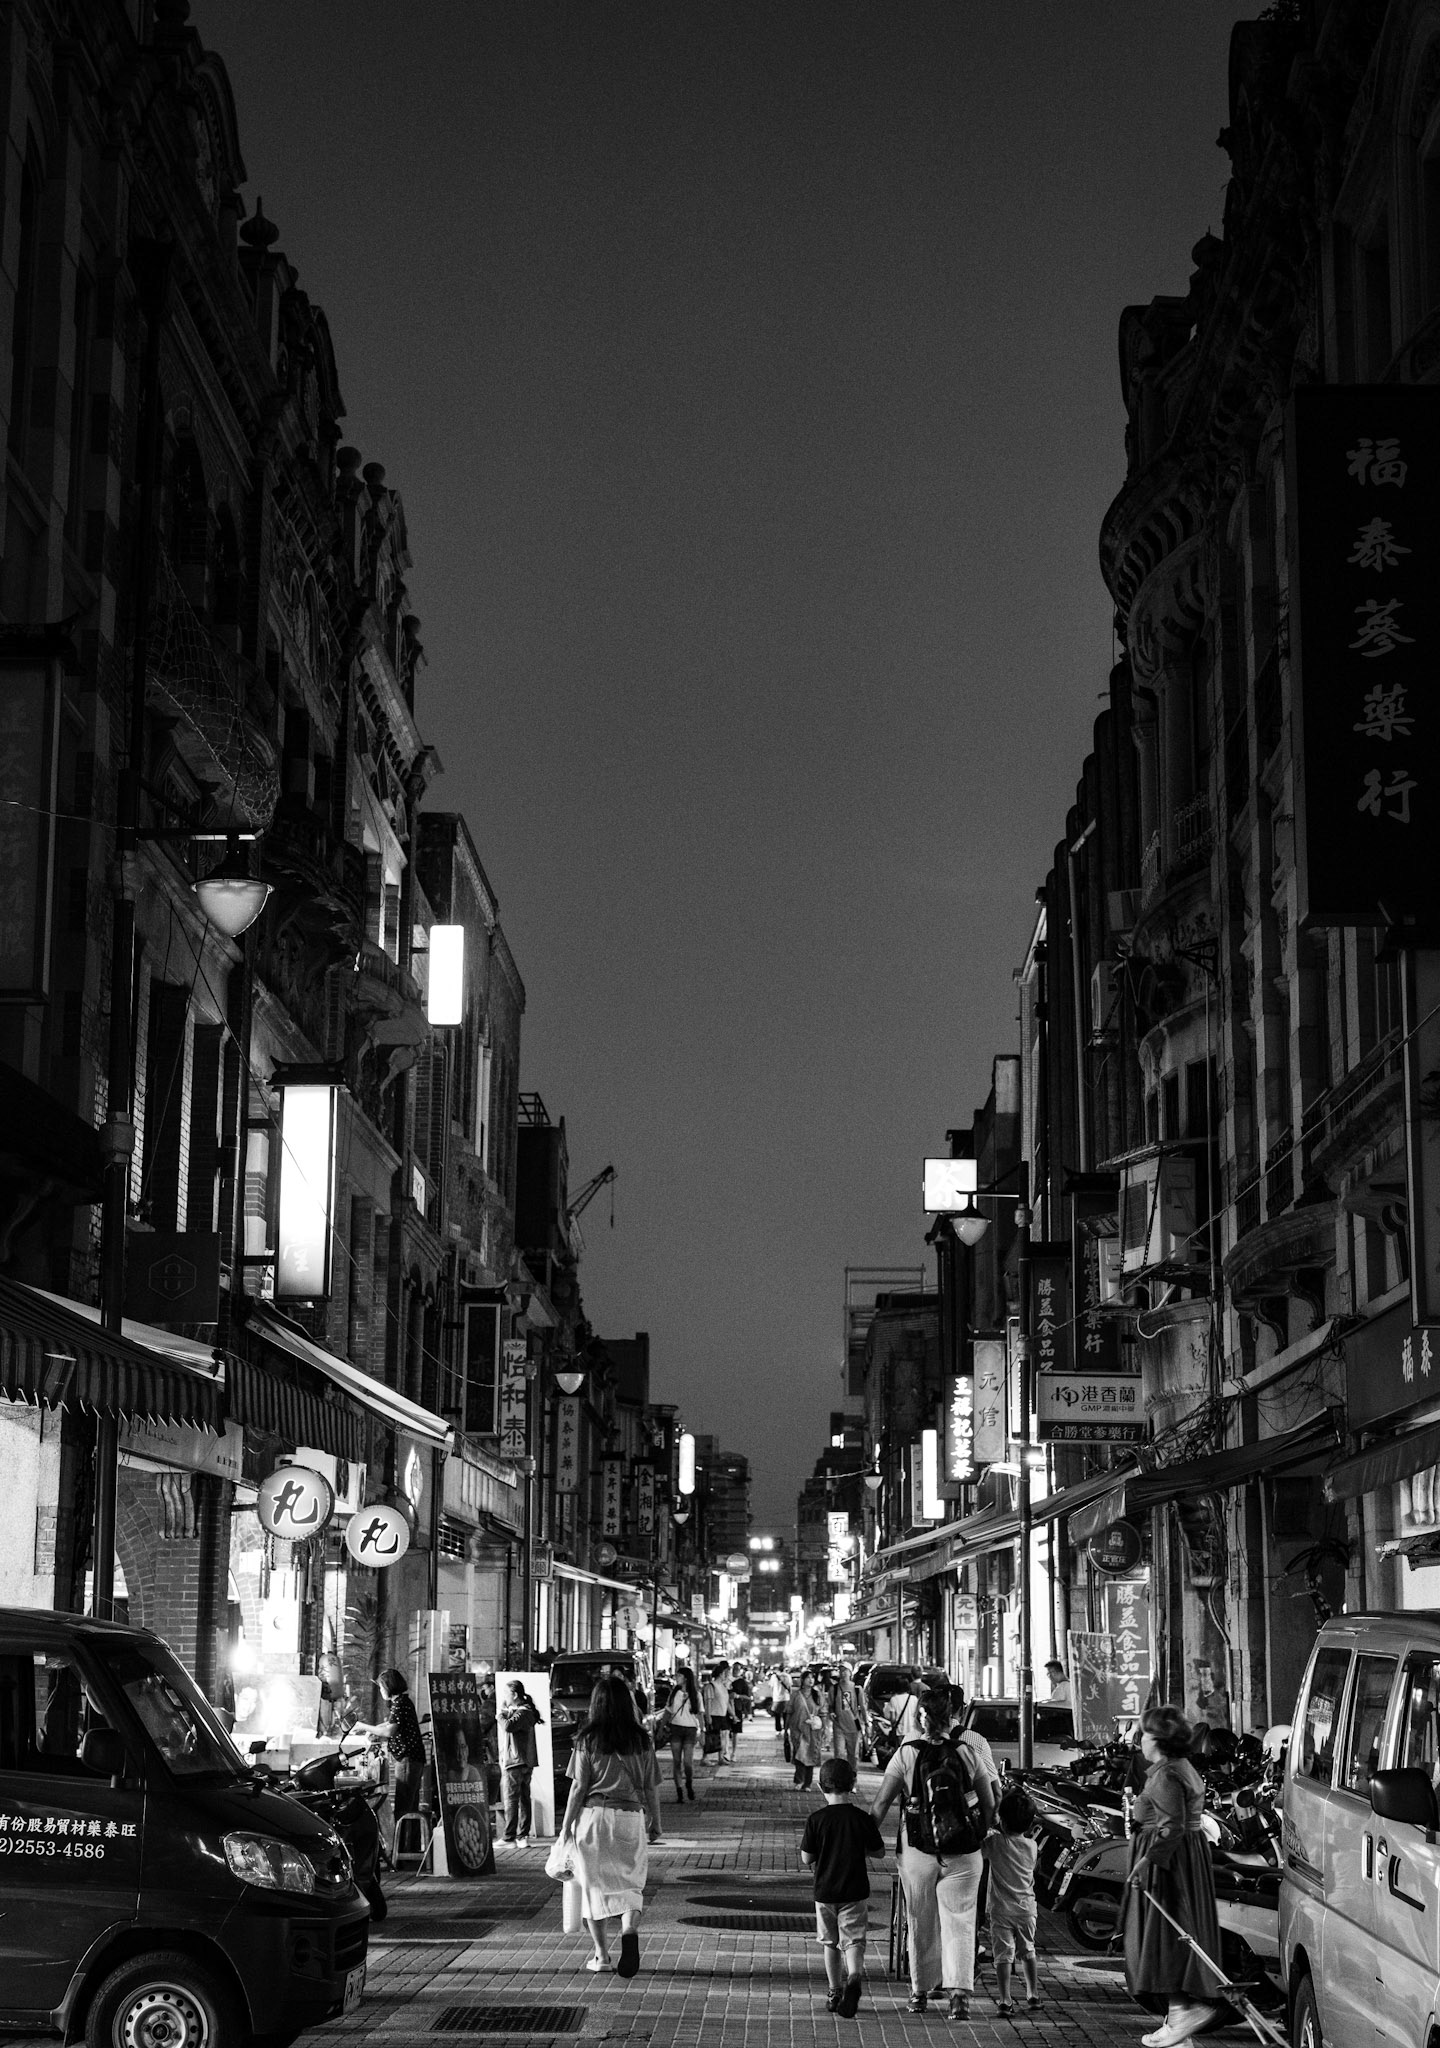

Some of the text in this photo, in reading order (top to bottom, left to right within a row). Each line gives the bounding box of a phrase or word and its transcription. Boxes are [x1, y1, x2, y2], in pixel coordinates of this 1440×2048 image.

[1346, 437, 1419, 824] 福泰蔘藥行
[502, 1351, 526, 1447] 怡和泰
[979, 1372, 999, 1427] 元信
[1081, 1404, 1102, 1412] GMP
[1082, 1386, 1135, 1403] 港香蘭
[950, 1376, 974, 1479] 王福記茗茶
[273, 1480, 317, 1525] 丸
[361, 1517, 398, 1553] 丸
[1116, 1585, 1142, 1715] 勝益食品公司
